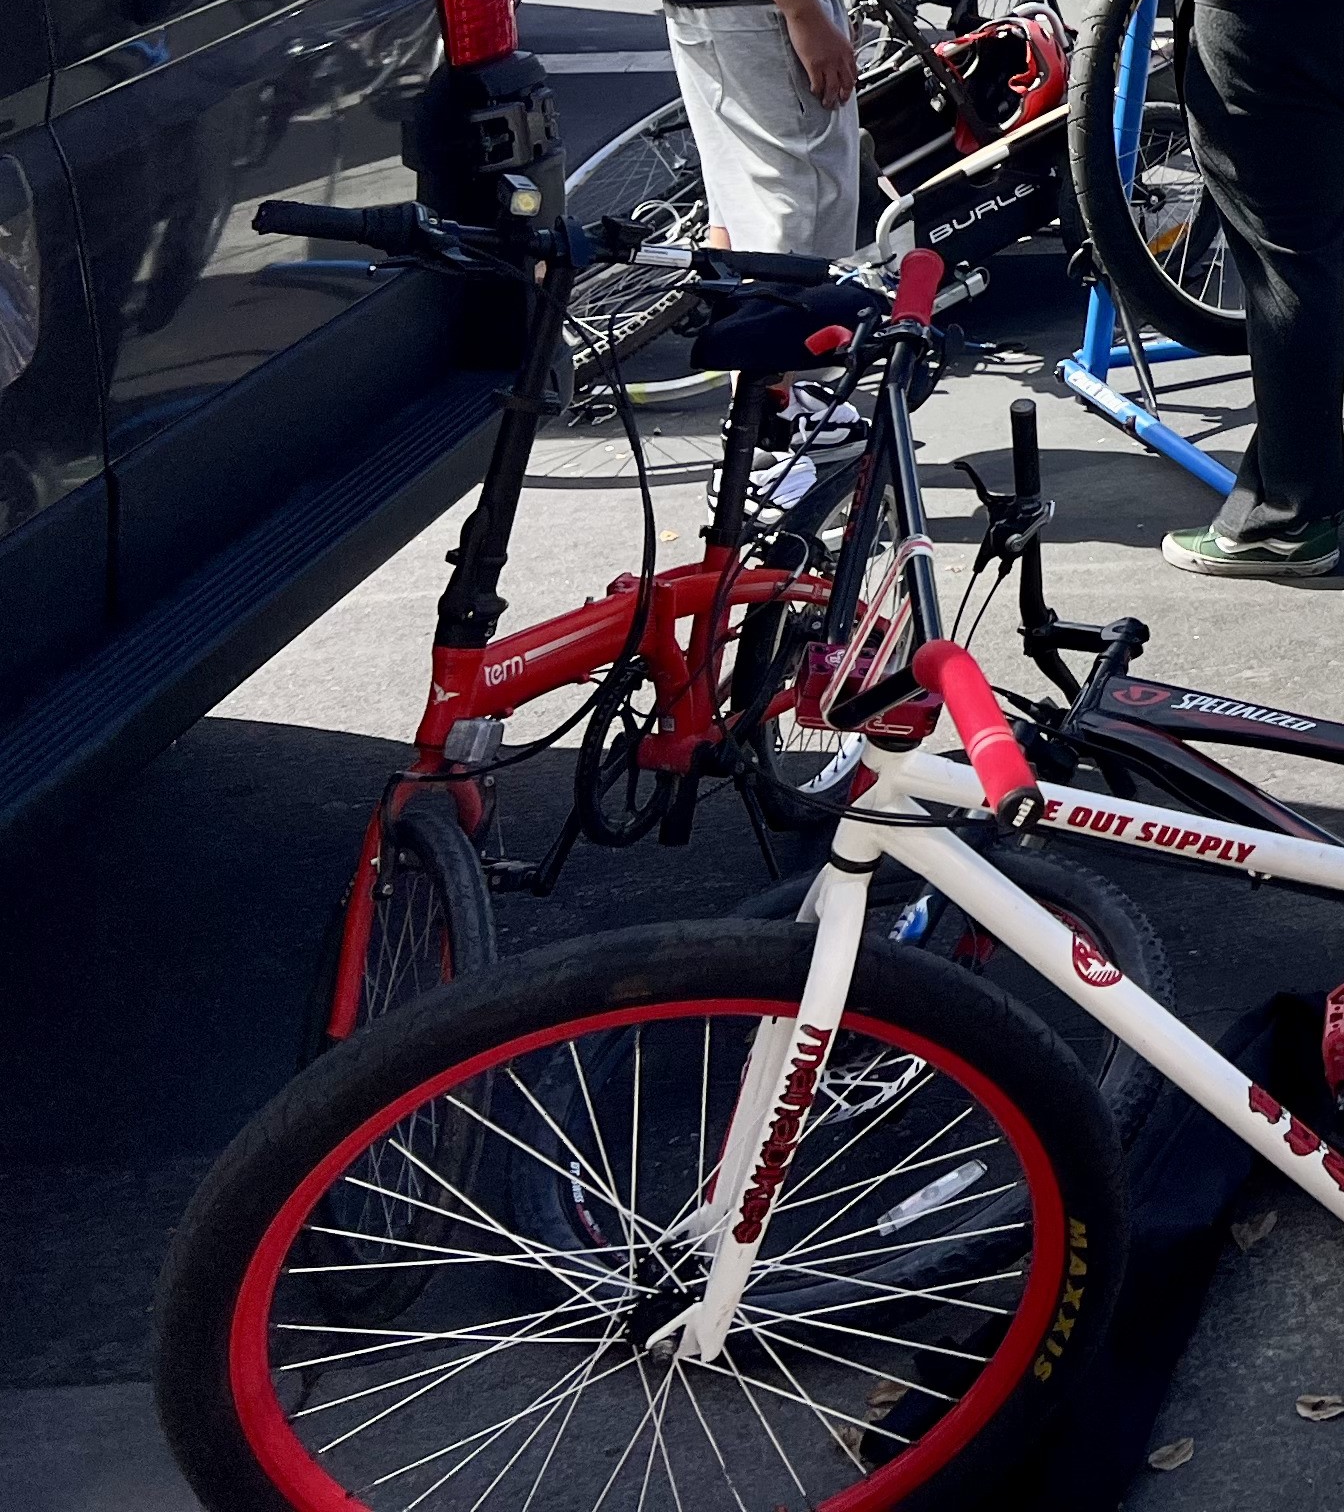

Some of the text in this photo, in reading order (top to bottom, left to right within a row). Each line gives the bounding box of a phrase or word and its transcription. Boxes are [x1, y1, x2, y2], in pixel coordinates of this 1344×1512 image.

[929, 183, 1036, 245] BURLE
[1170, 693, 1317, 732] SPECIALIZED
[1067, 805, 1134, 837] OUT
[1135, 821, 1256, 864] SUPPLY
[1034, 1216, 1088, 1383] MAXXIS
